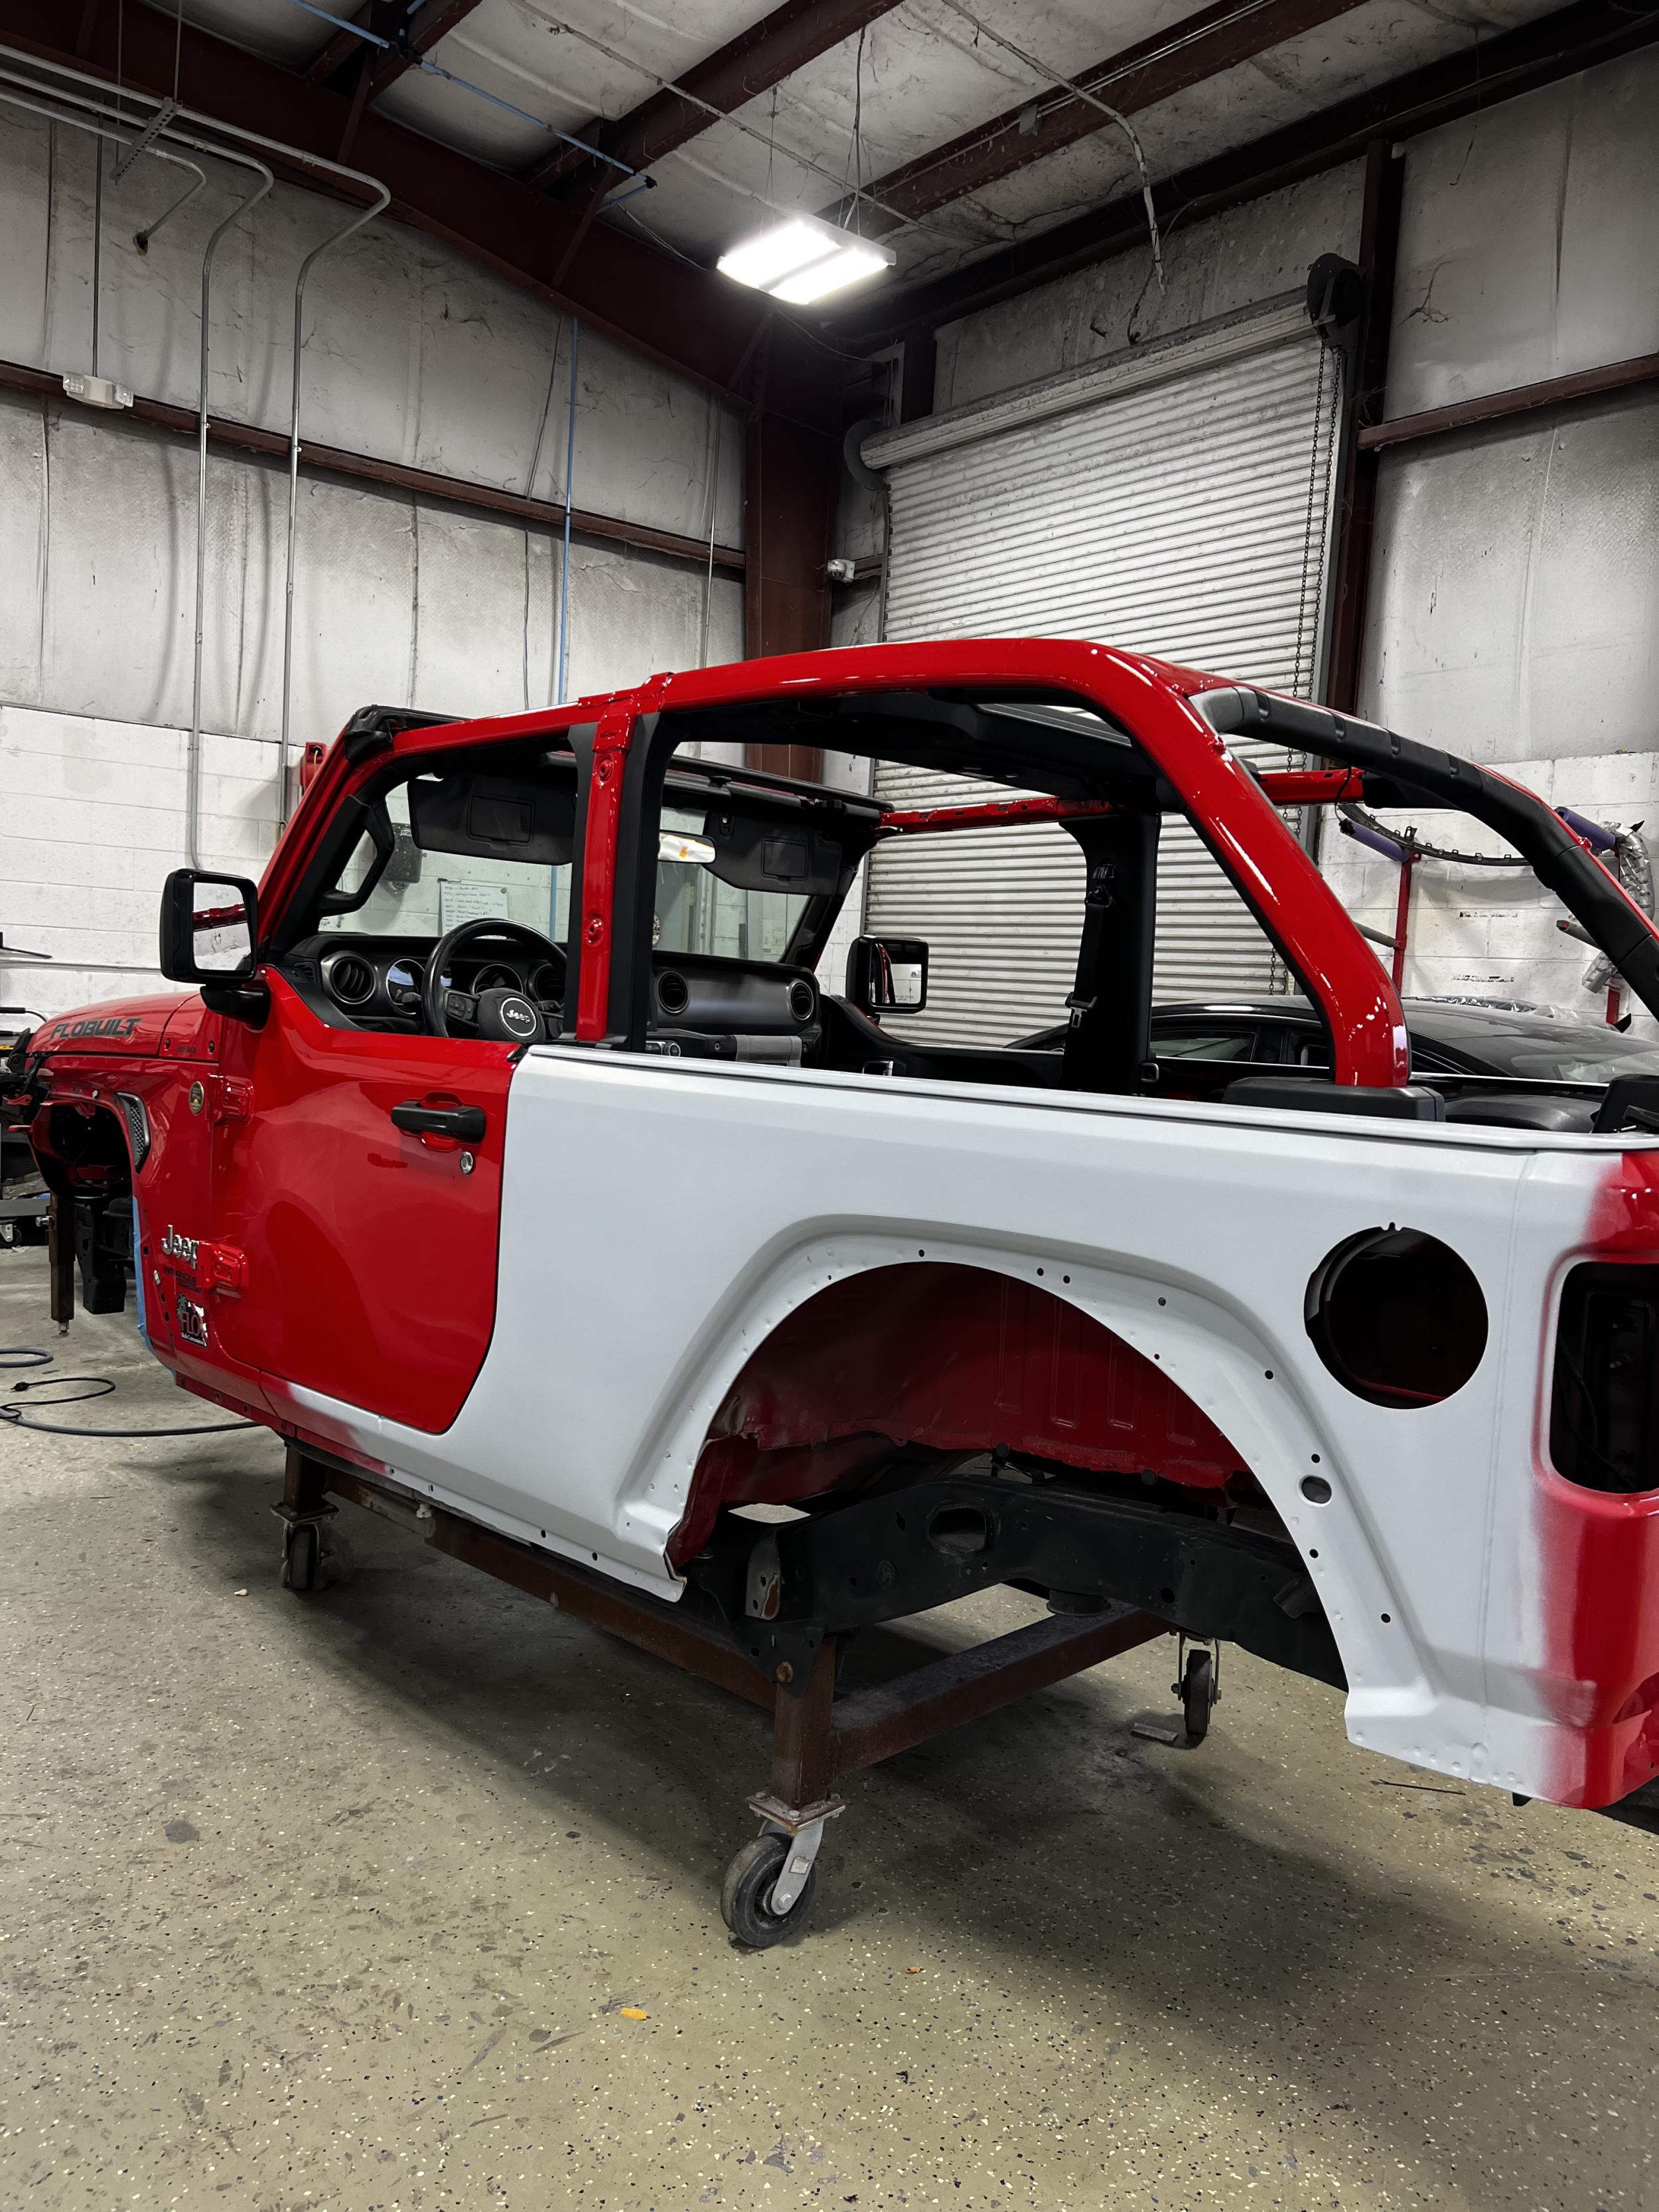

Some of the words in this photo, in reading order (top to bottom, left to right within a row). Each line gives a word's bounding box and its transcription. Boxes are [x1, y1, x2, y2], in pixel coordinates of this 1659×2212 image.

[506, 1009, 530, 1024] Jeep
[50, 1017, 143, 1040] FLOBUILT
[161, 1224, 199, 1270] Jeep
